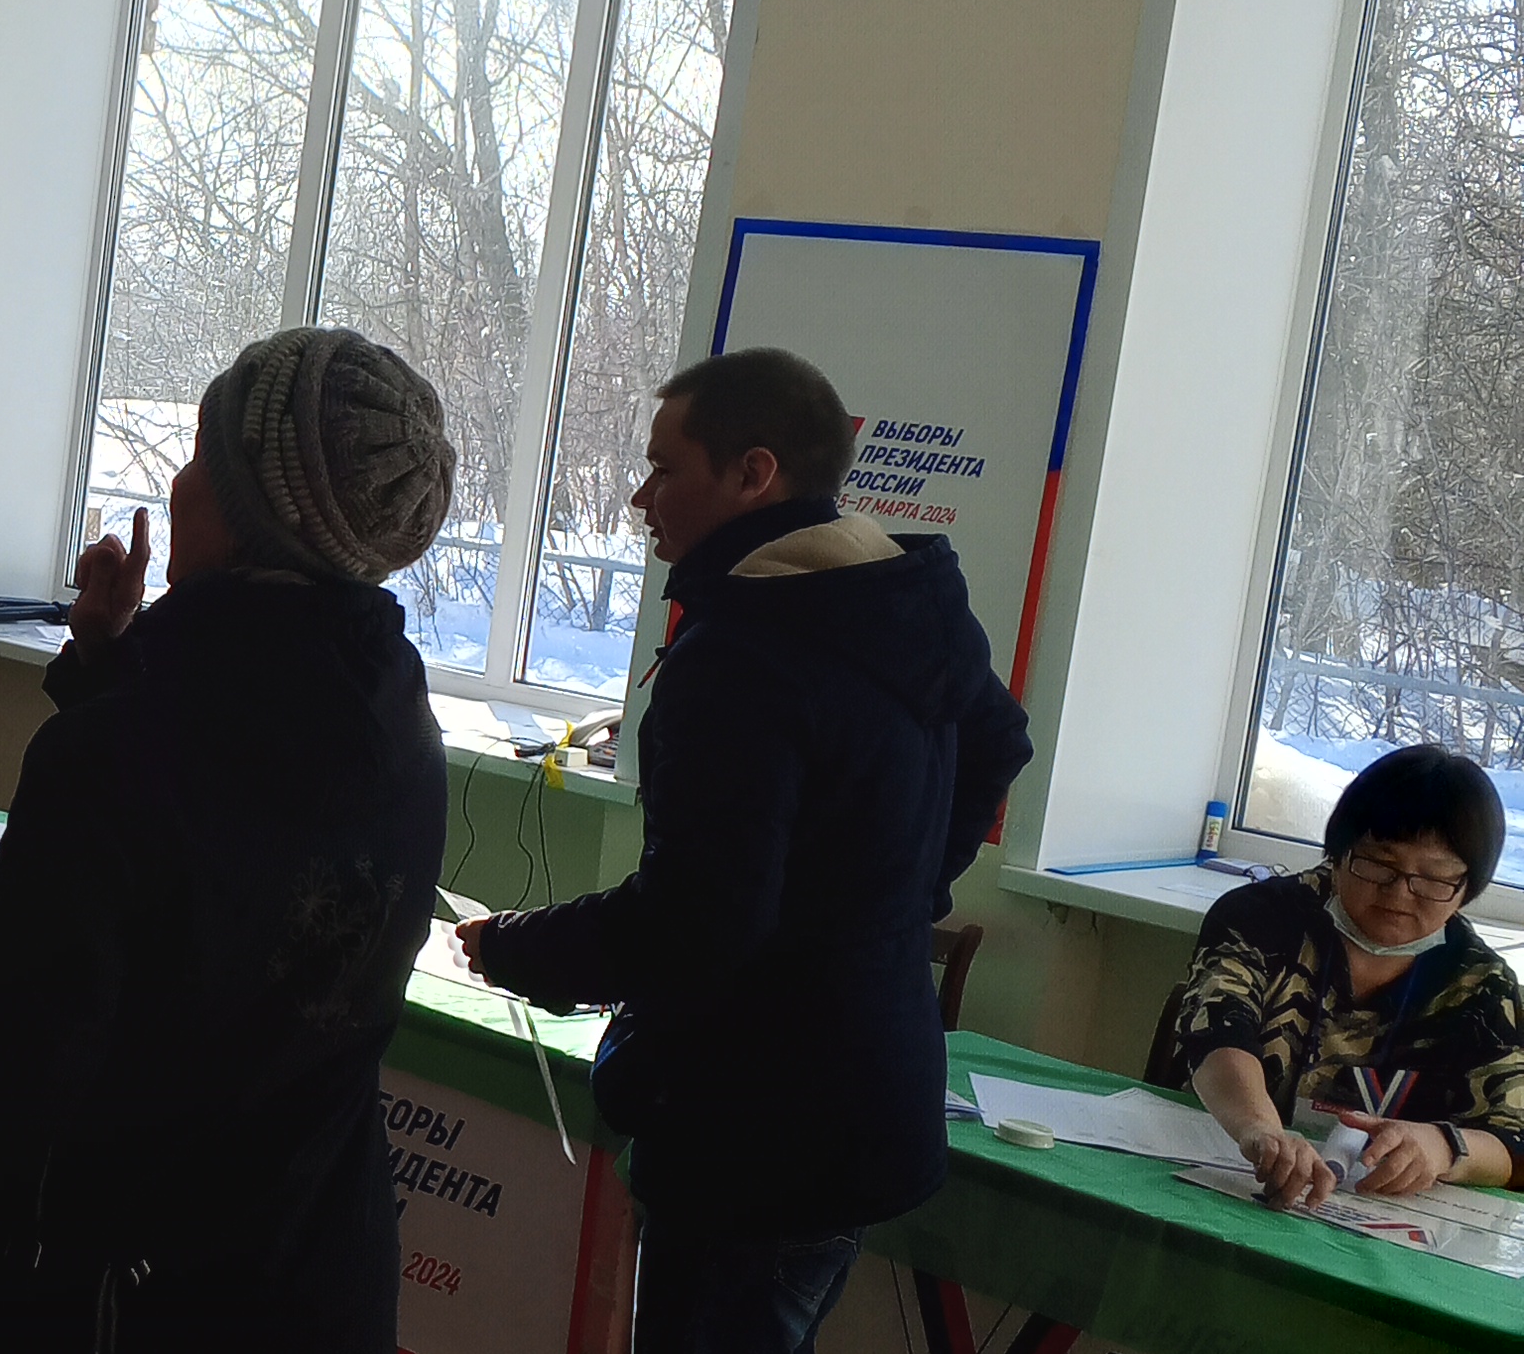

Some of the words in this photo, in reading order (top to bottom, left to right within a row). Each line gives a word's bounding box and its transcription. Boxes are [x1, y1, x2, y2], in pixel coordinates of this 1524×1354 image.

[871, 419, 964, 447] ВЫБОРЫ
[858, 445, 986, 478] ПРЕЗИДЕНТА
[844, 469, 926, 496] РОССИИ
[871, 498, 921, 520] МАРТА
[920, 505, 958, 525] 2024
[402, 1251, 462, 1296] 2024
